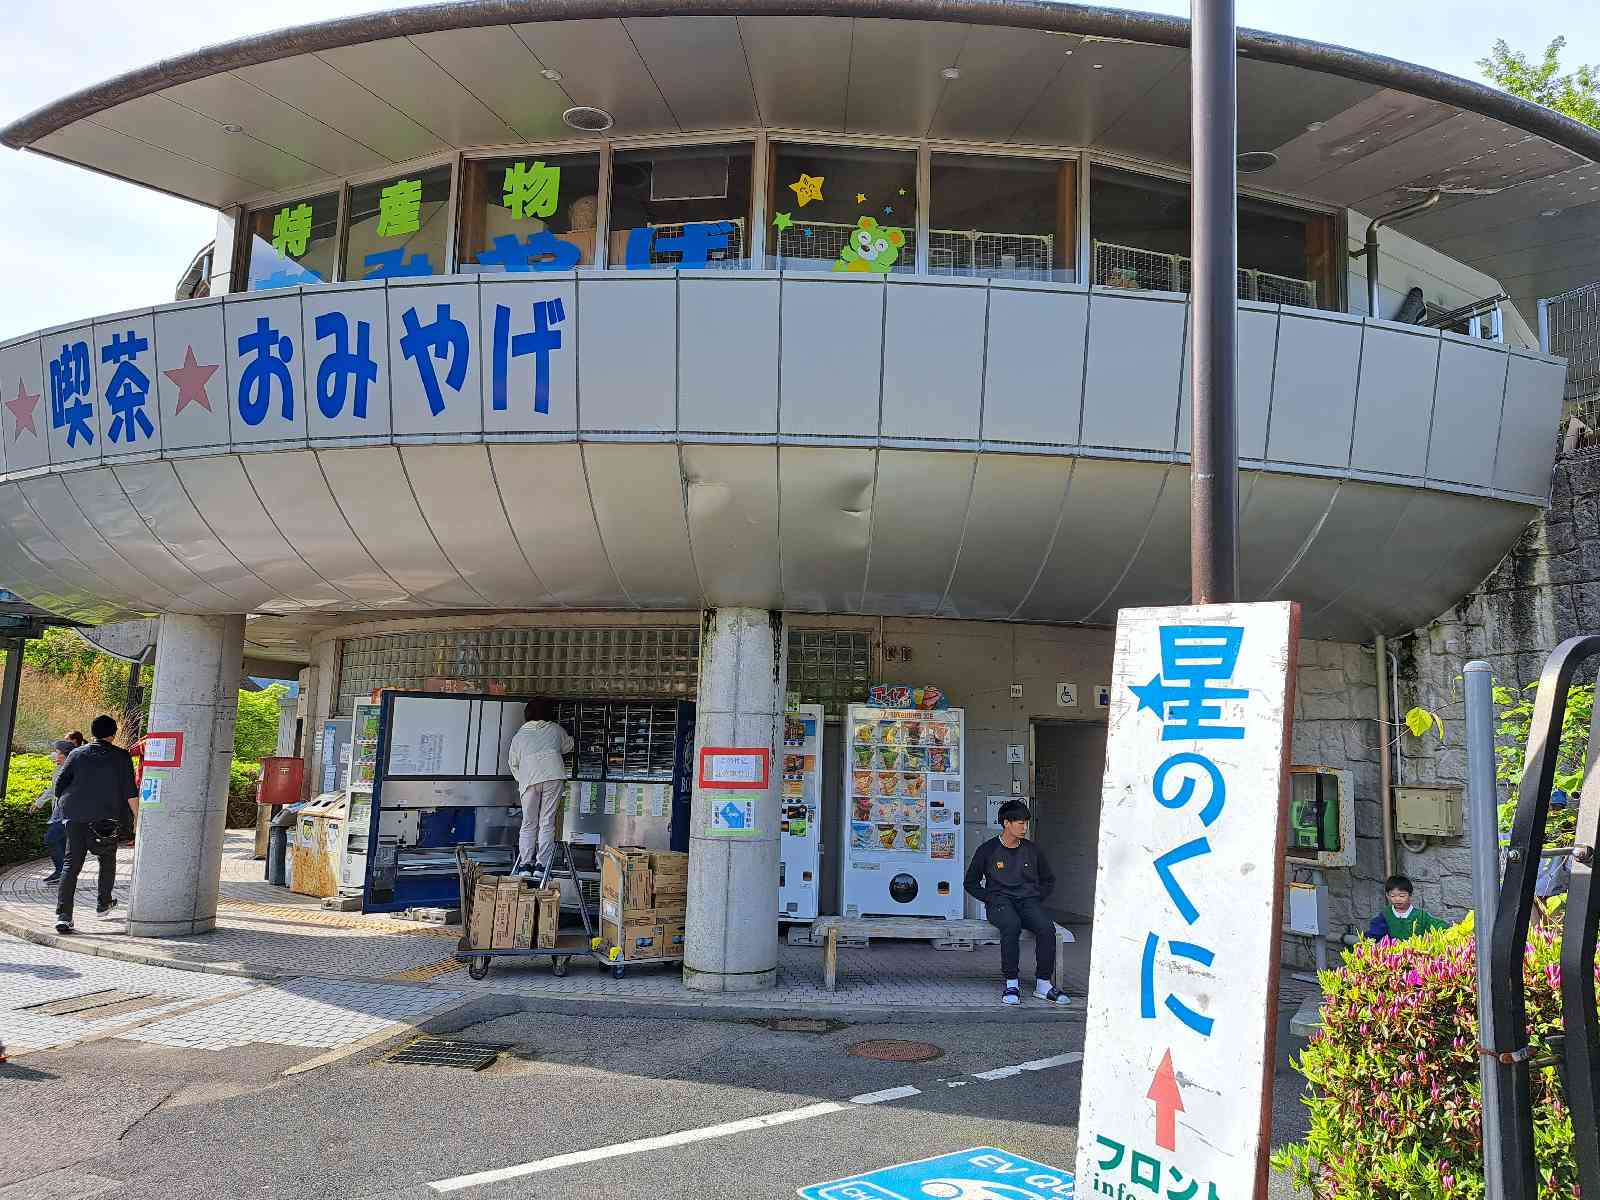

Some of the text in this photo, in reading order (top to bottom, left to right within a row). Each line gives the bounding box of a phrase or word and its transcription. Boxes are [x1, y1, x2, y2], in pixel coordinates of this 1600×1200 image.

[272, 161, 561, 257] 特産物
[49, 297, 566, 449] 喫茶 おみやげ
[1127, 624, 1250, 1038] 星のくに
[968, 1154, 1029, 1175] EV
